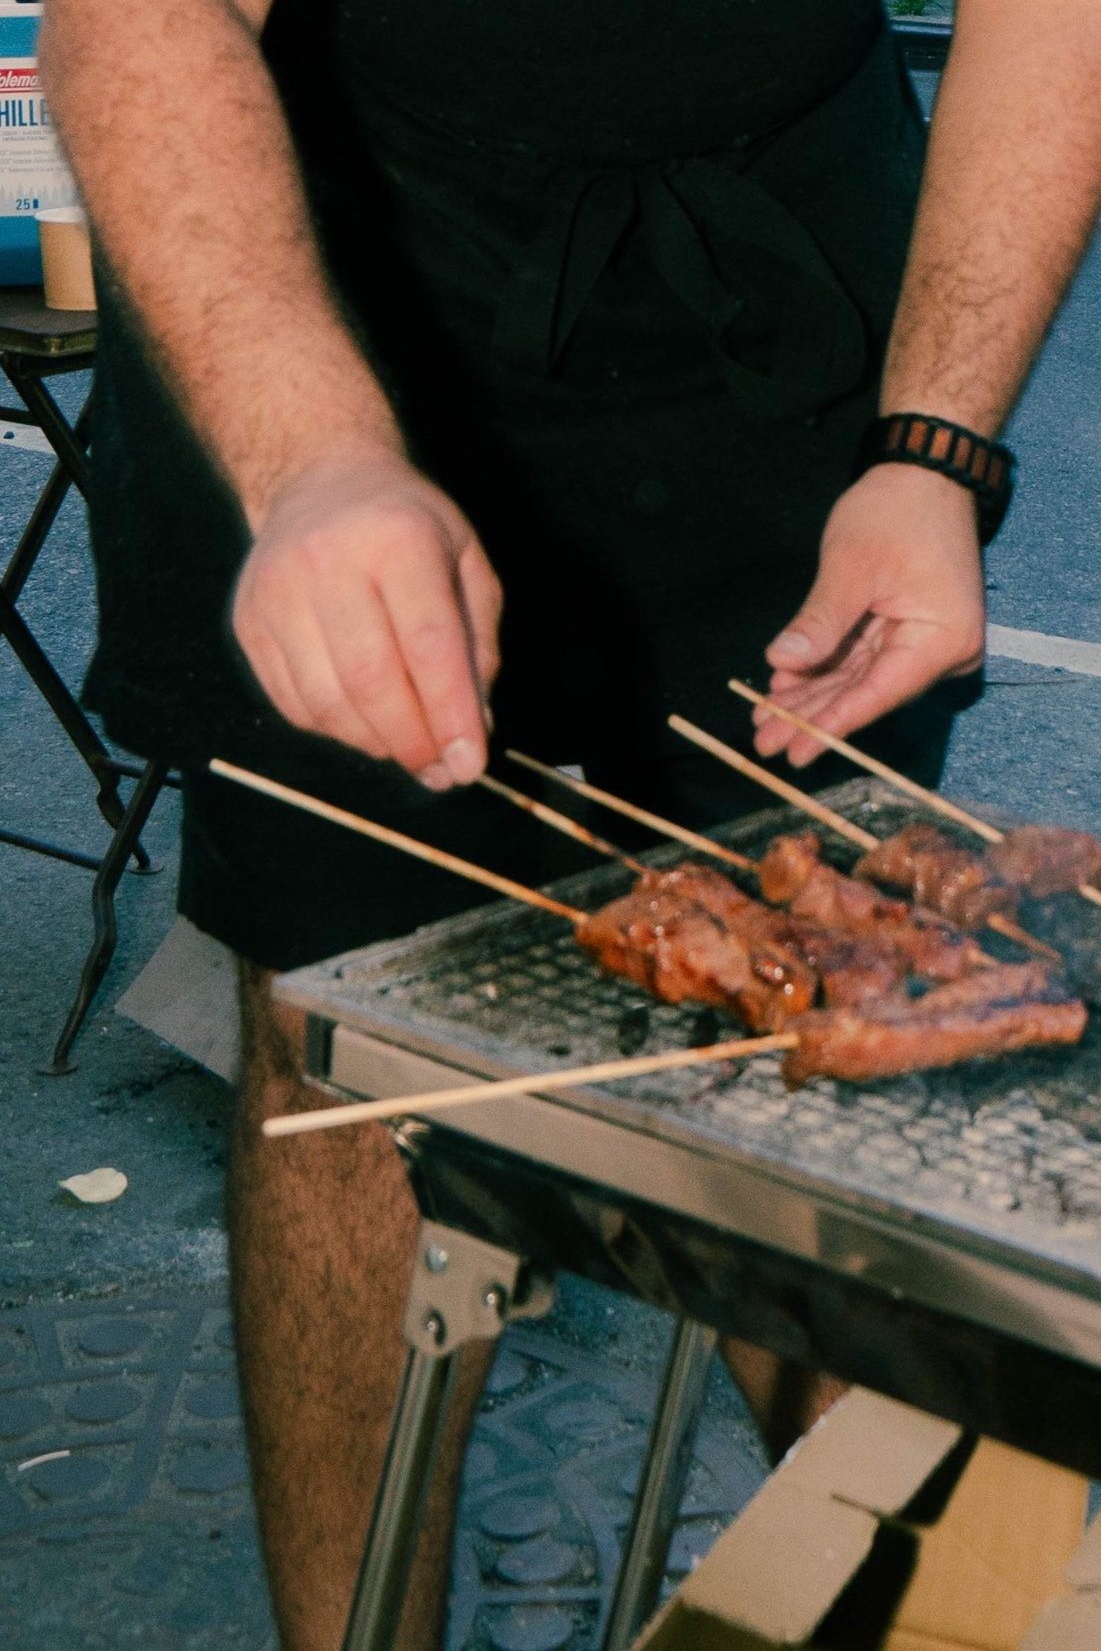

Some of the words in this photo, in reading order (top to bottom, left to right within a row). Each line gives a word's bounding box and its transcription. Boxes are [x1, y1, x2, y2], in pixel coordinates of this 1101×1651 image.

[0, 70, 39, 88] olema
[0, 99, 50, 127] HILLE
[16, 199, 30, 210] 25
